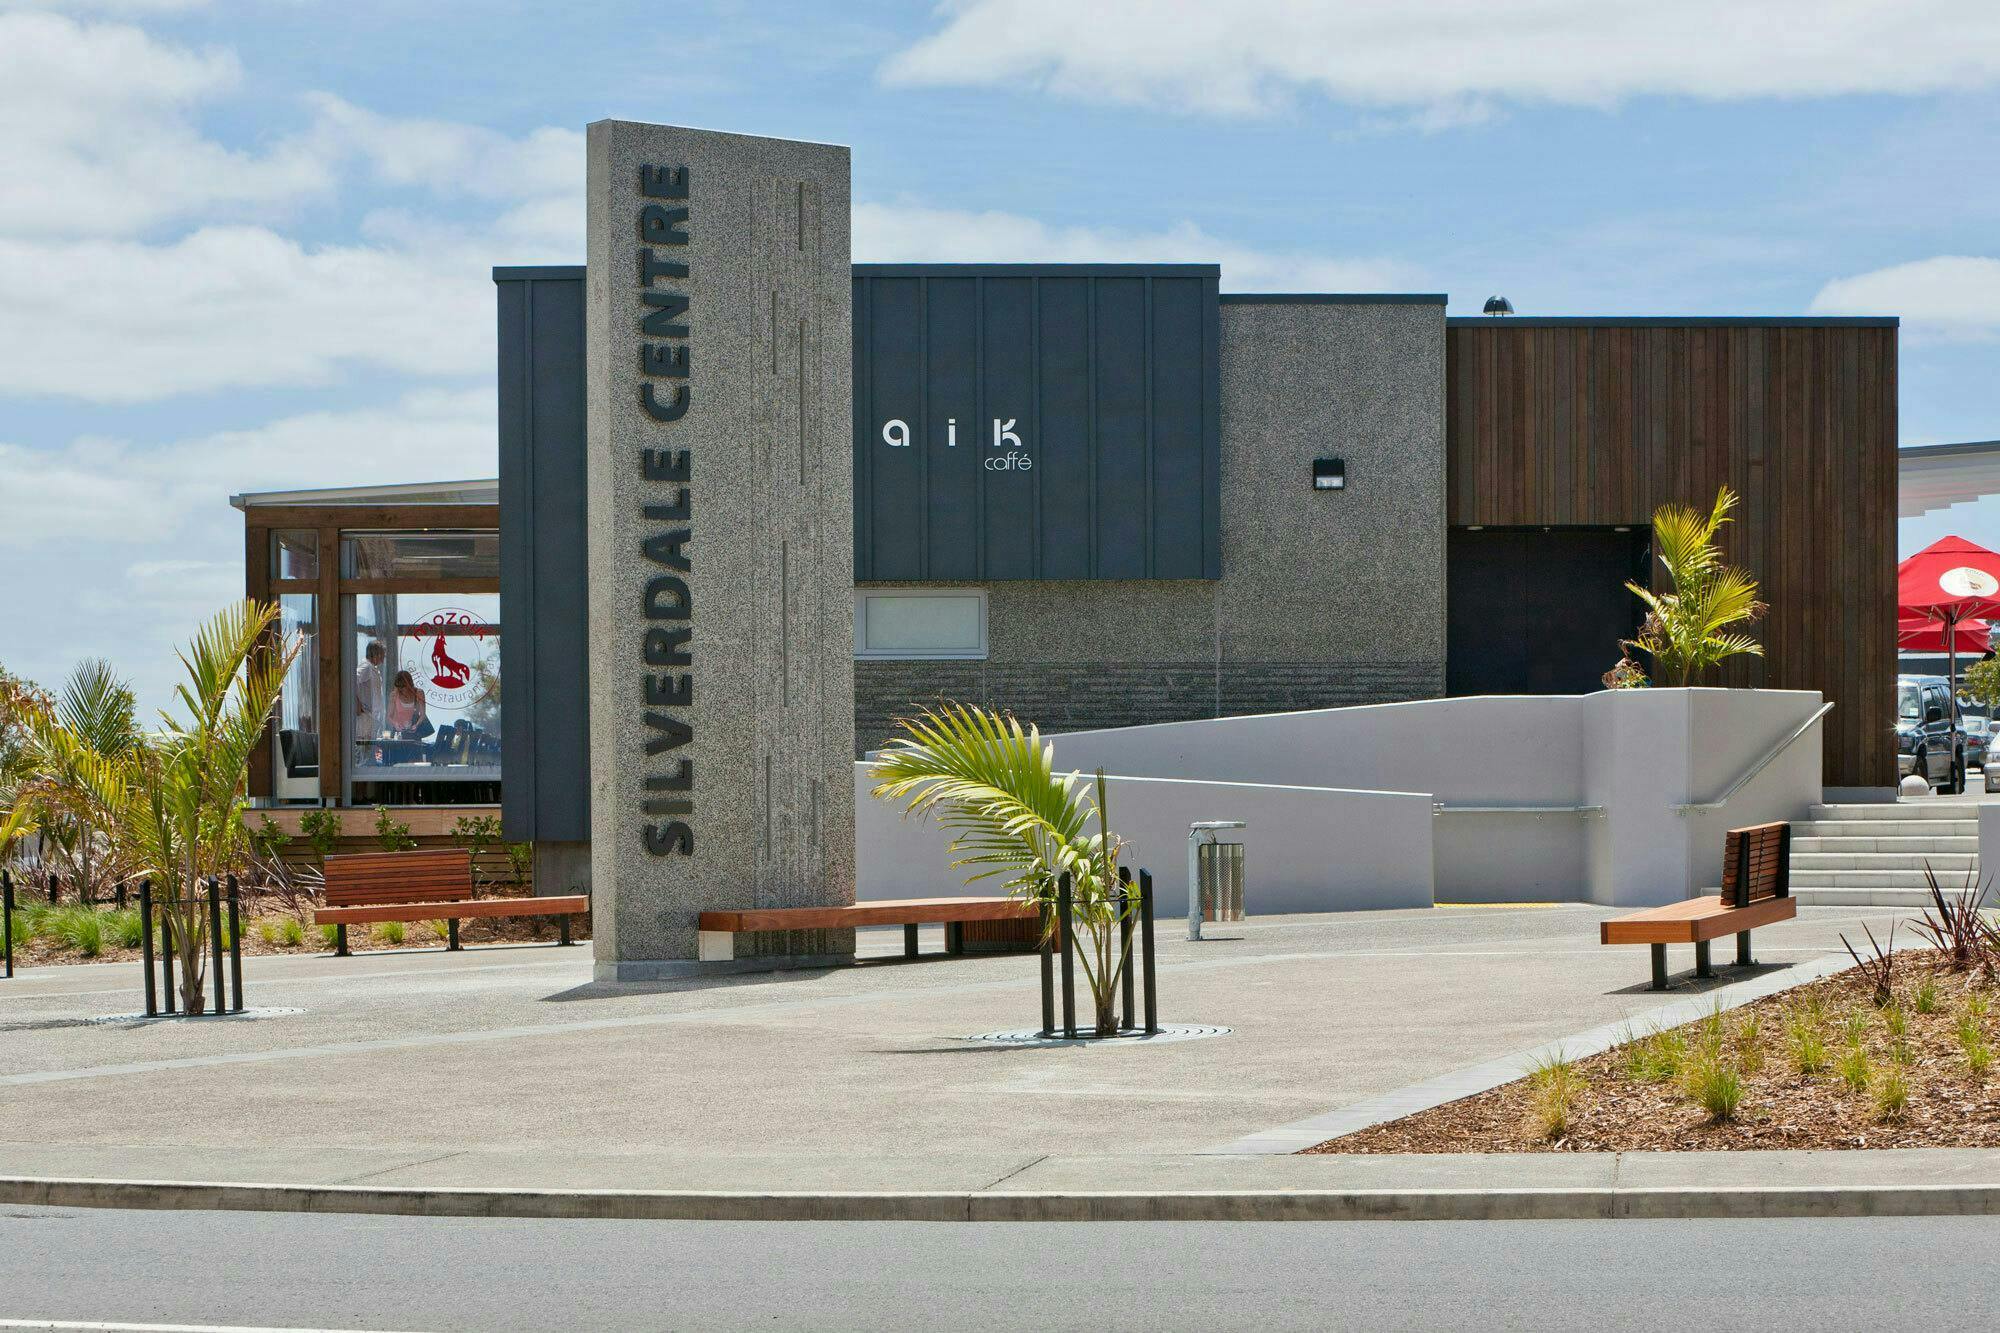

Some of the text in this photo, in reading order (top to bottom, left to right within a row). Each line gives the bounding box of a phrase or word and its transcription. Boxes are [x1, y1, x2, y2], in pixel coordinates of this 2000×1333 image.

[984, 451, 1032, 471] caffé
[642, 164, 694, 857] SILVERDALE CENTRE
[426, 680, 485, 703] restaurant
